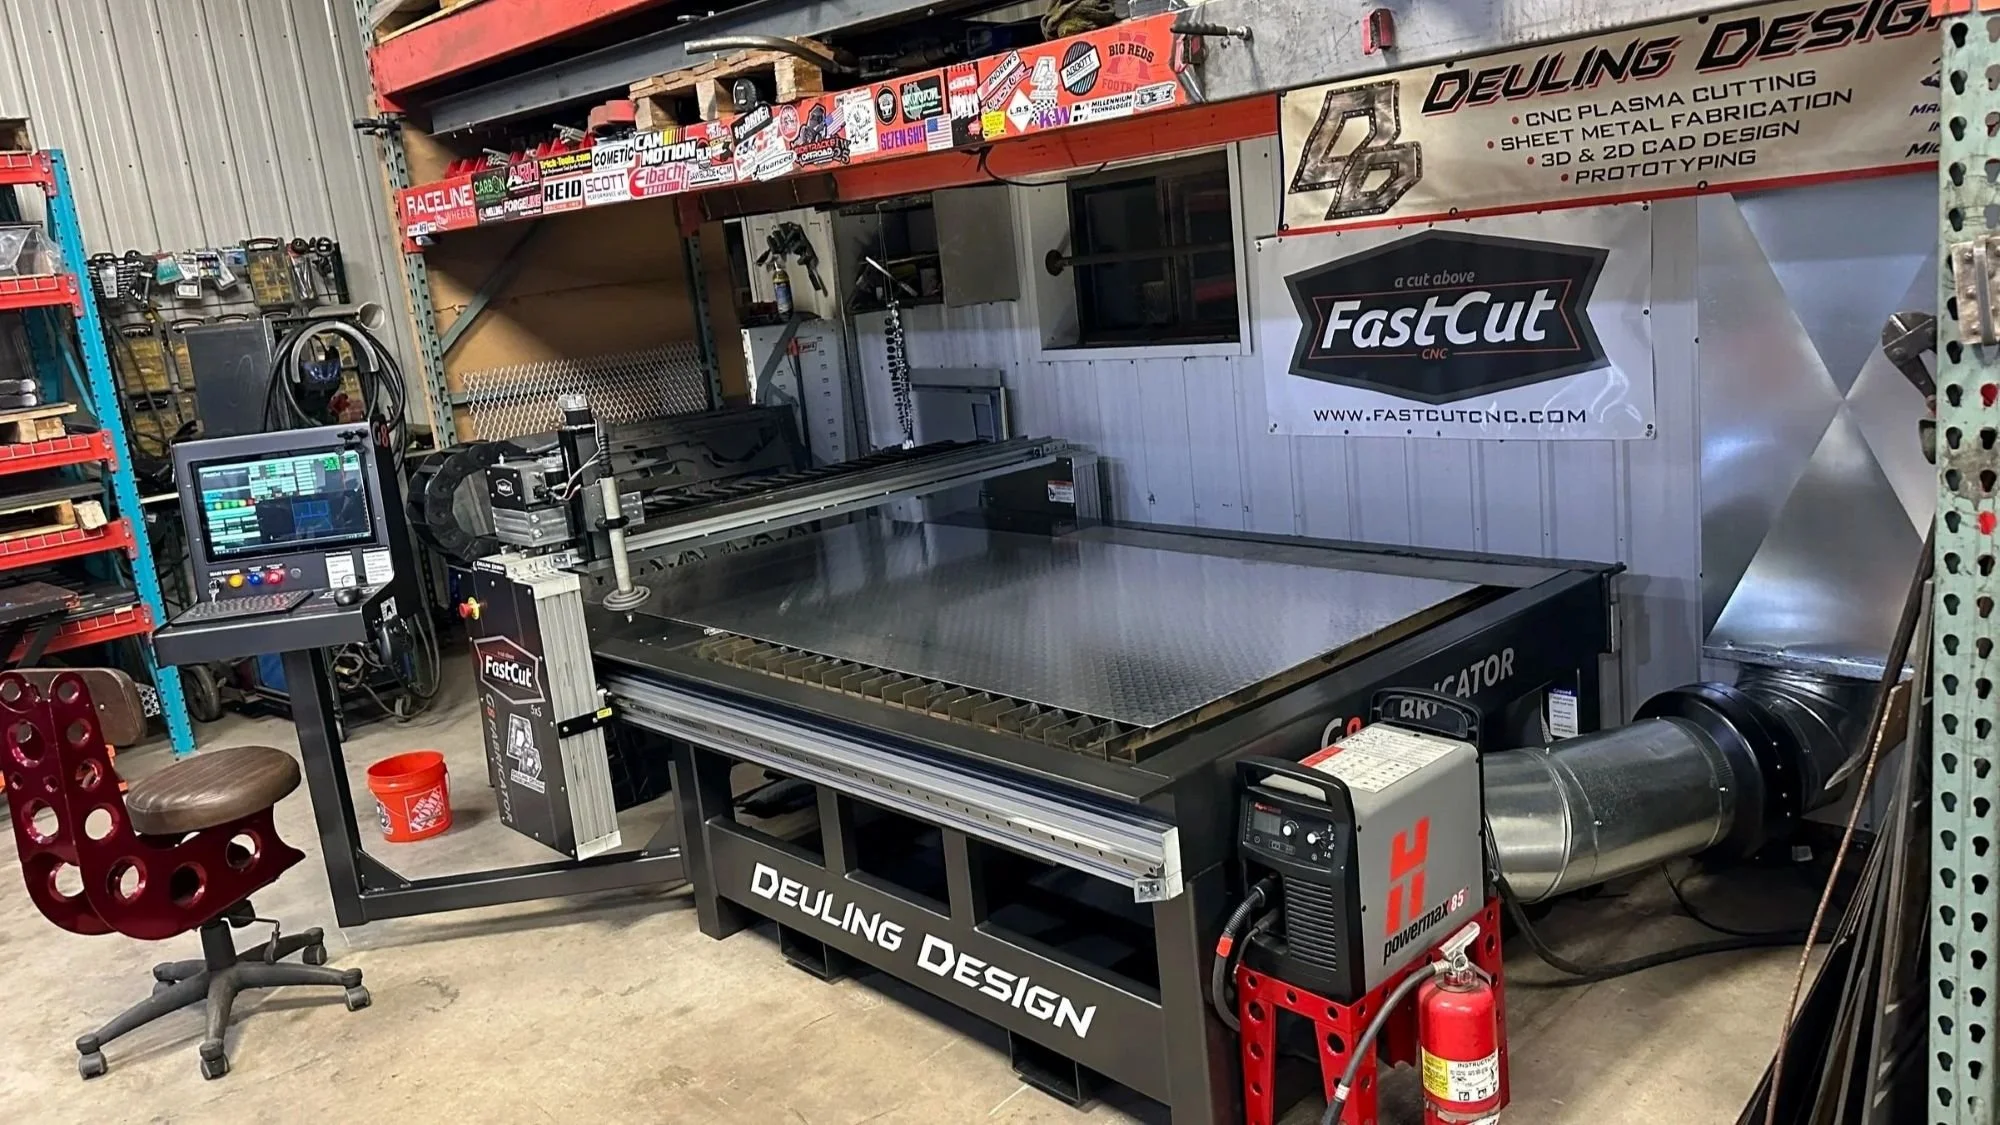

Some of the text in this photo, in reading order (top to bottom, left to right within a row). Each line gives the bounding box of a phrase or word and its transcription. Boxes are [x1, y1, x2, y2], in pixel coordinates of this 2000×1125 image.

[1108, 43, 1154, 63] BIG REDS
[1421, 0, 1940, 116] DEULING DESIG
[1065, 54, 1092, 77] ABBOTT
[1091, 95, 1132, 107] MILLENNIUM
[1091, 102, 1132, 114] TECHNOLOGIES
[1526, 70, 1816, 127] CNC PLASMA CUTTING
[1040, 105, 1071, 129] KW
[1501, 88, 1853, 151] SHEET METAL FABRICATION
[635, 132, 663, 151] CAM
[881, 128, 907, 150] SE7EN
[1541, 120, 1800, 168] 3D & 2D CAD DESIGN
[594, 144, 634, 167] COMETIC
[641, 140, 697, 167] MOTION
[753, 152, 794, 178] Advanced
[801, 147, 833, 160] OFFROAD
[1575, 150, 1756, 184] PROTOTYPING
[473, 176, 505, 195] CARBON
[544, 180, 582, 202] REID
[585, 173, 625, 193] SCOTT
[630, 163, 681, 197] Eibach
[405, 184, 474, 216] RACELINE
[587, 191, 617, 201] PERFORMANCE
[446, 207, 475, 221] WHEELS
[1394, 270, 1475, 288] a cut above
[1321, 289, 1556, 349] FastCut
[1421, 348, 1448, 360] CNC
[1313, 408, 1587, 424] WWW.FASTCUTCNC.COM
[372, 421, 389, 447] G8
[485, 654, 532, 688] FastCut
[489, 718, 513, 823] FABRICATOR
[1383, 889, 1465, 966] powermax 85
[750, 862, 1097, 1039] DEULING DESIGN
